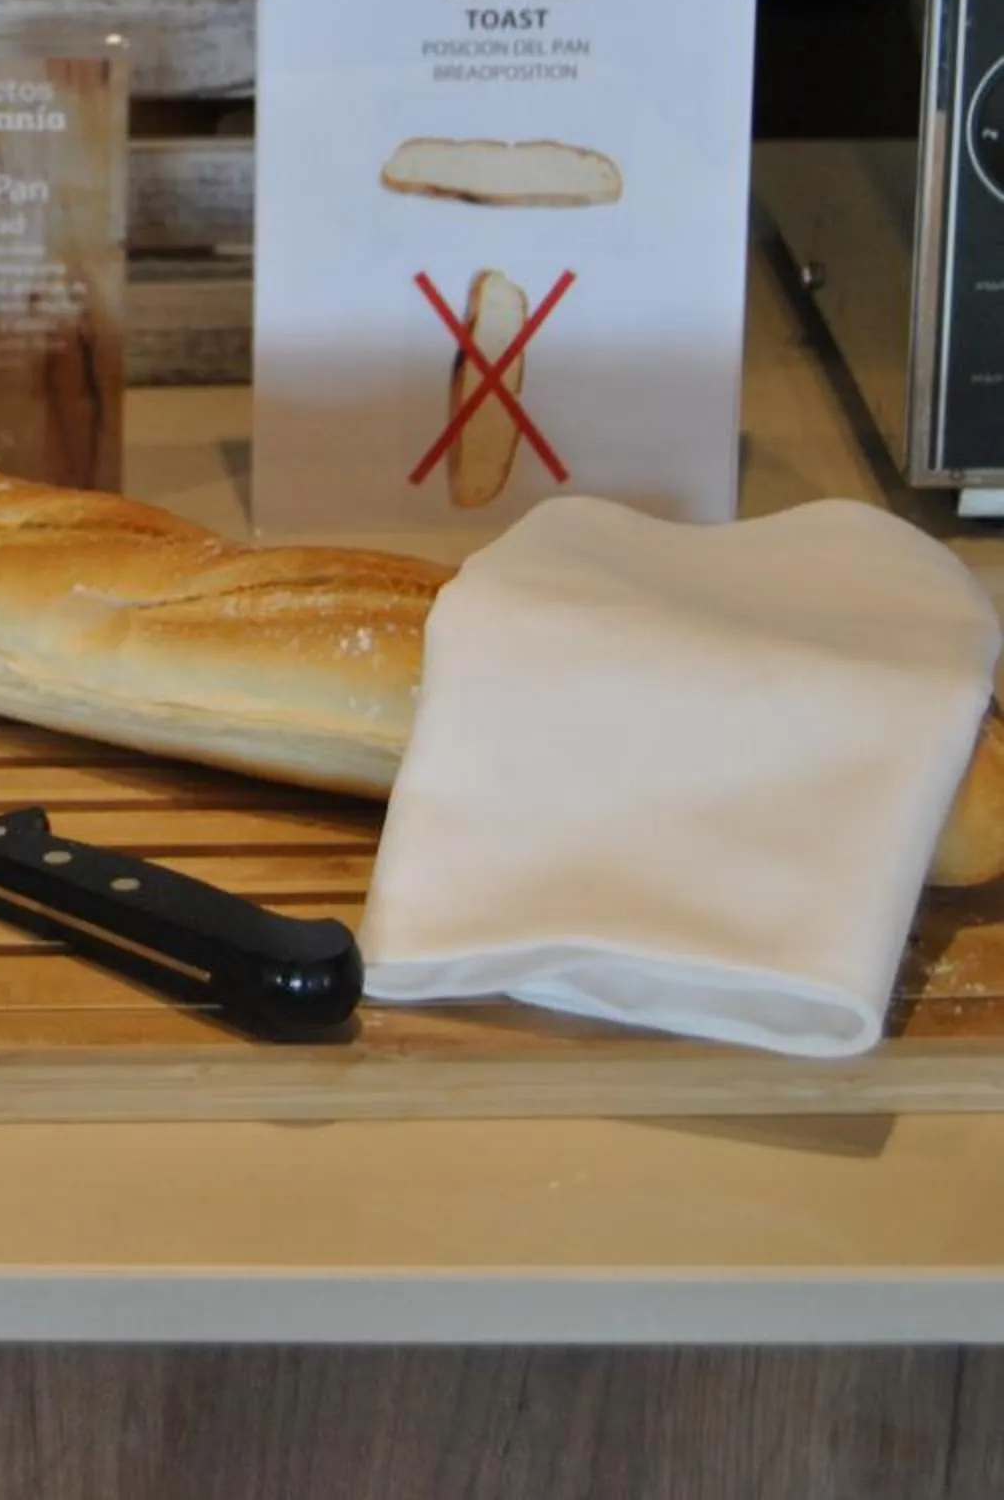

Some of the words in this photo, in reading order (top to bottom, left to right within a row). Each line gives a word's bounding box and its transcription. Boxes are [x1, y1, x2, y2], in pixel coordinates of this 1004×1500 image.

[465, 8, 549, 31] TOAST
[513, 39, 546, 57] DEL
[551, 37, 590, 56] PAN
